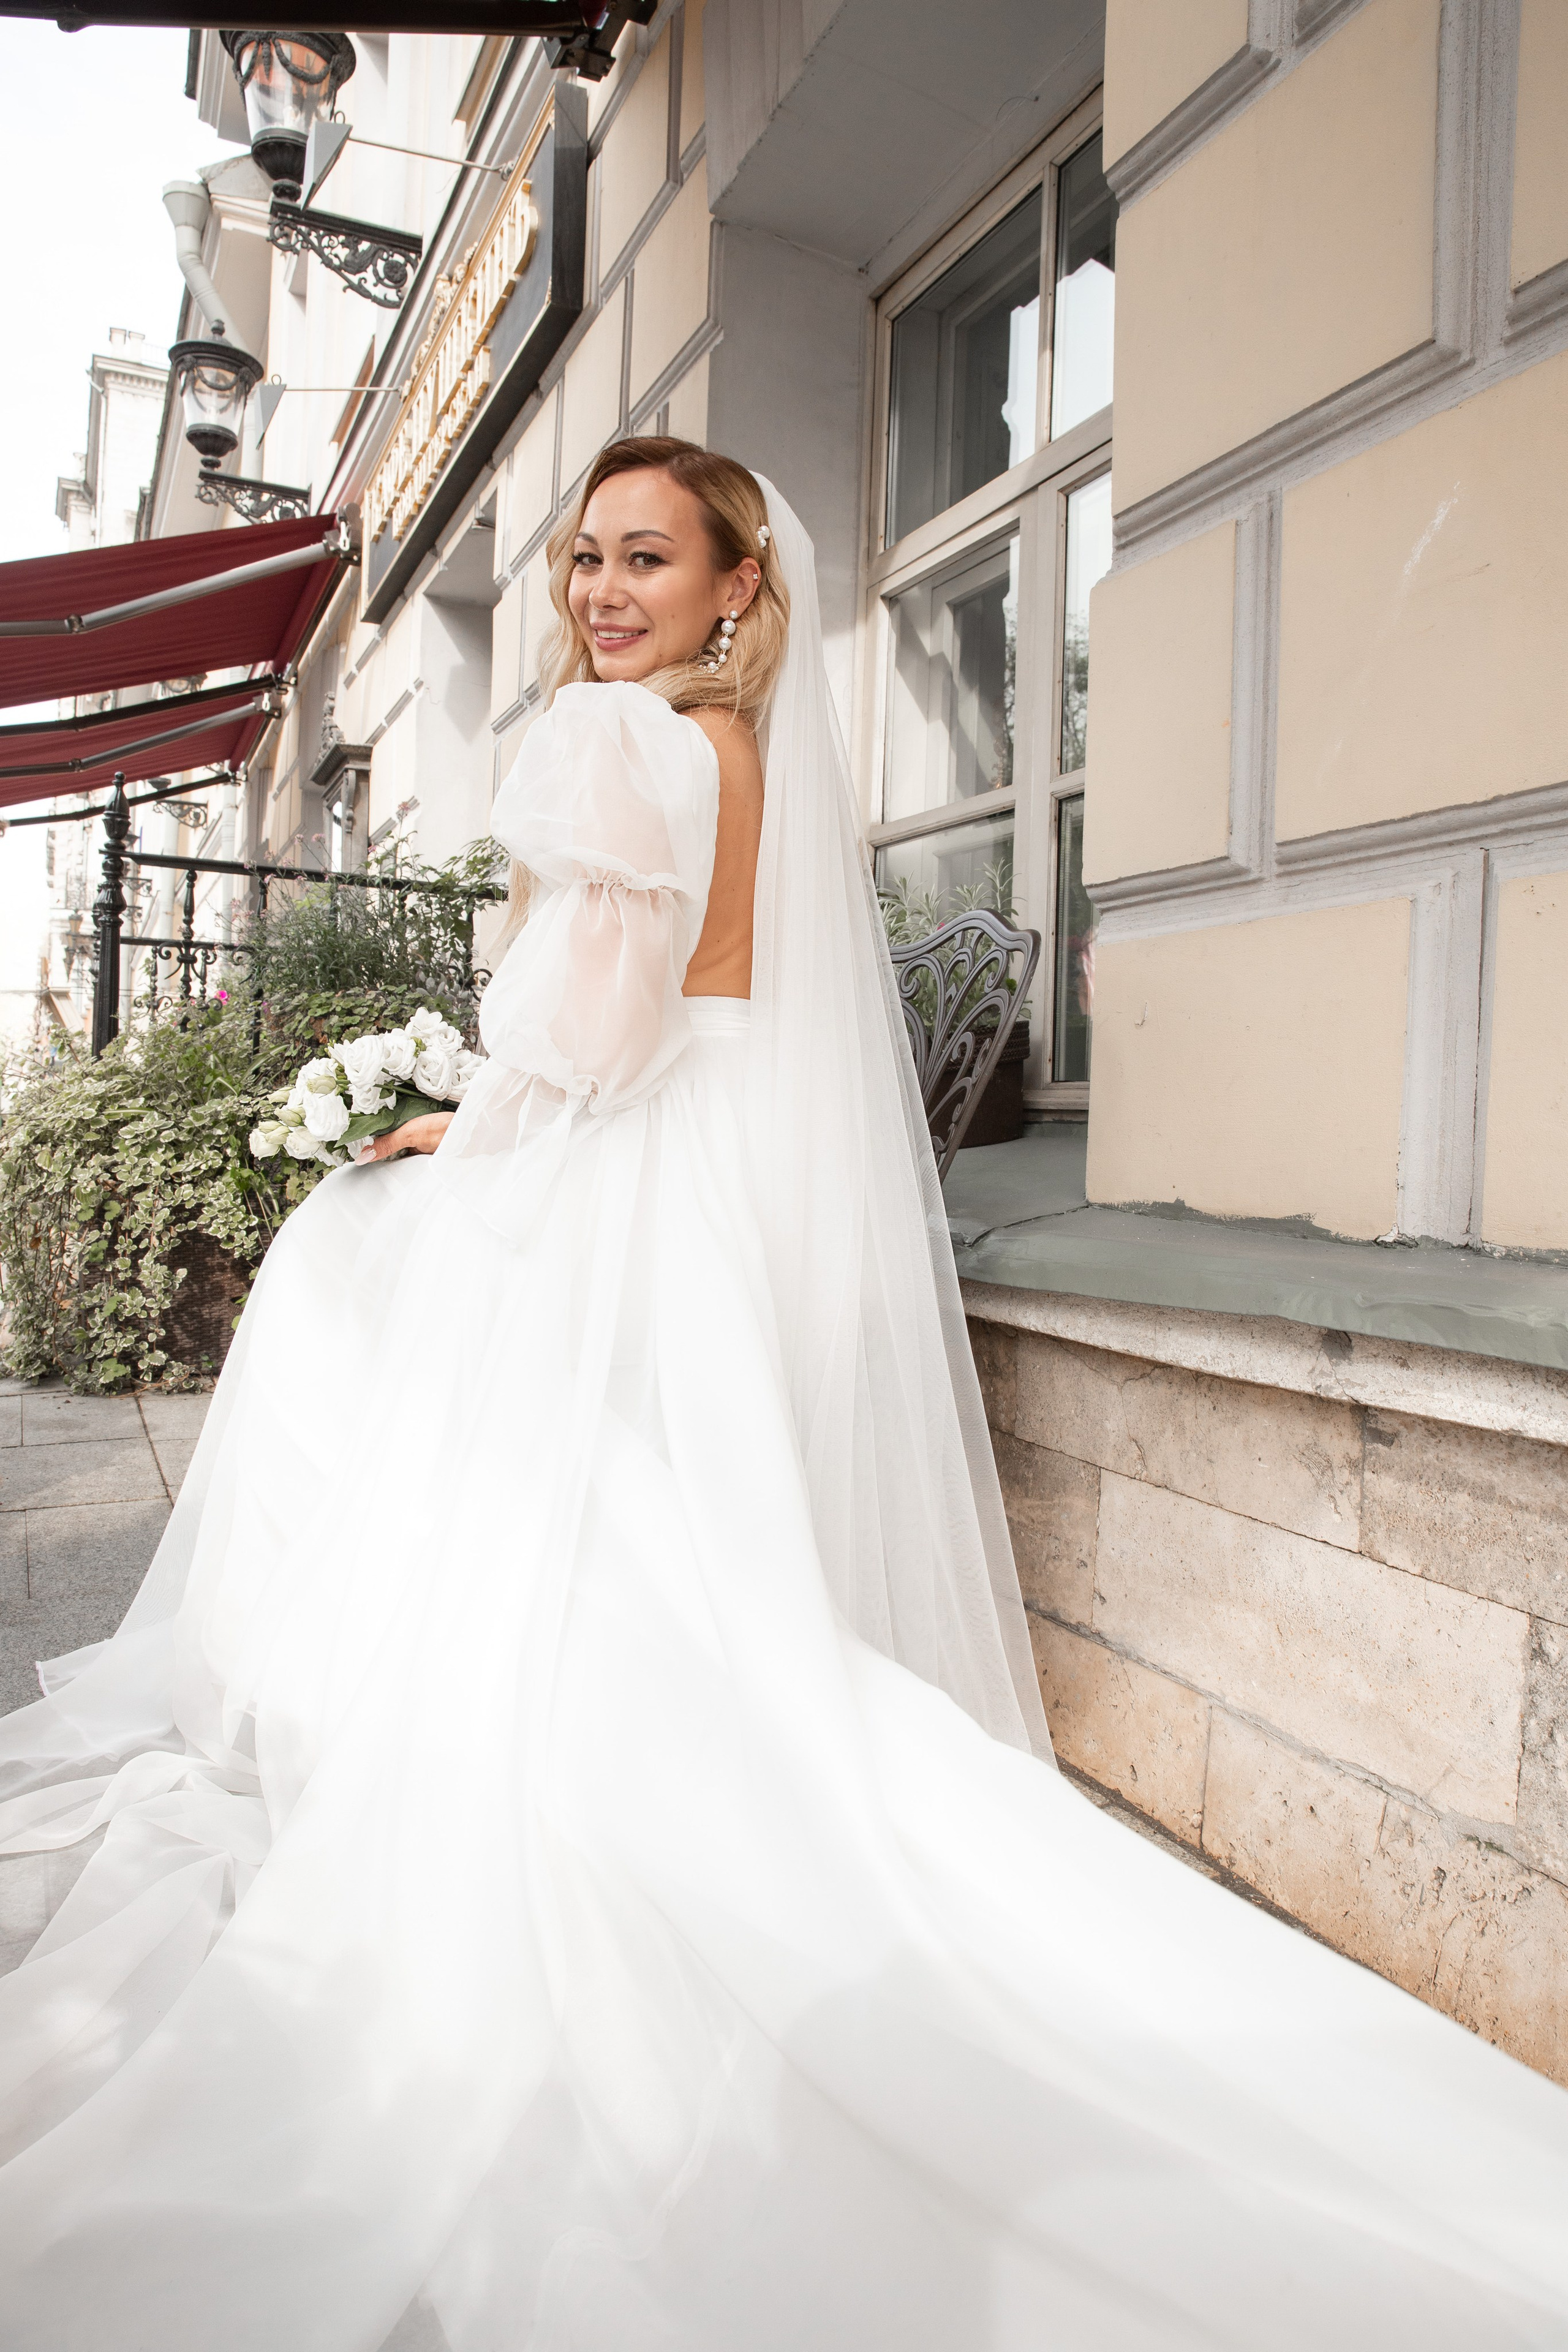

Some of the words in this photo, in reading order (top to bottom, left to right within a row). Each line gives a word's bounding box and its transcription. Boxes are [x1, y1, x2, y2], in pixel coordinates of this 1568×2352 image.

[371, 419, 412, 542] КАФЕ
[412, 179, 538, 464] ПУШКИНЪ
[392, 345, 490, 541] КОНДИТЕРСКАЯ
